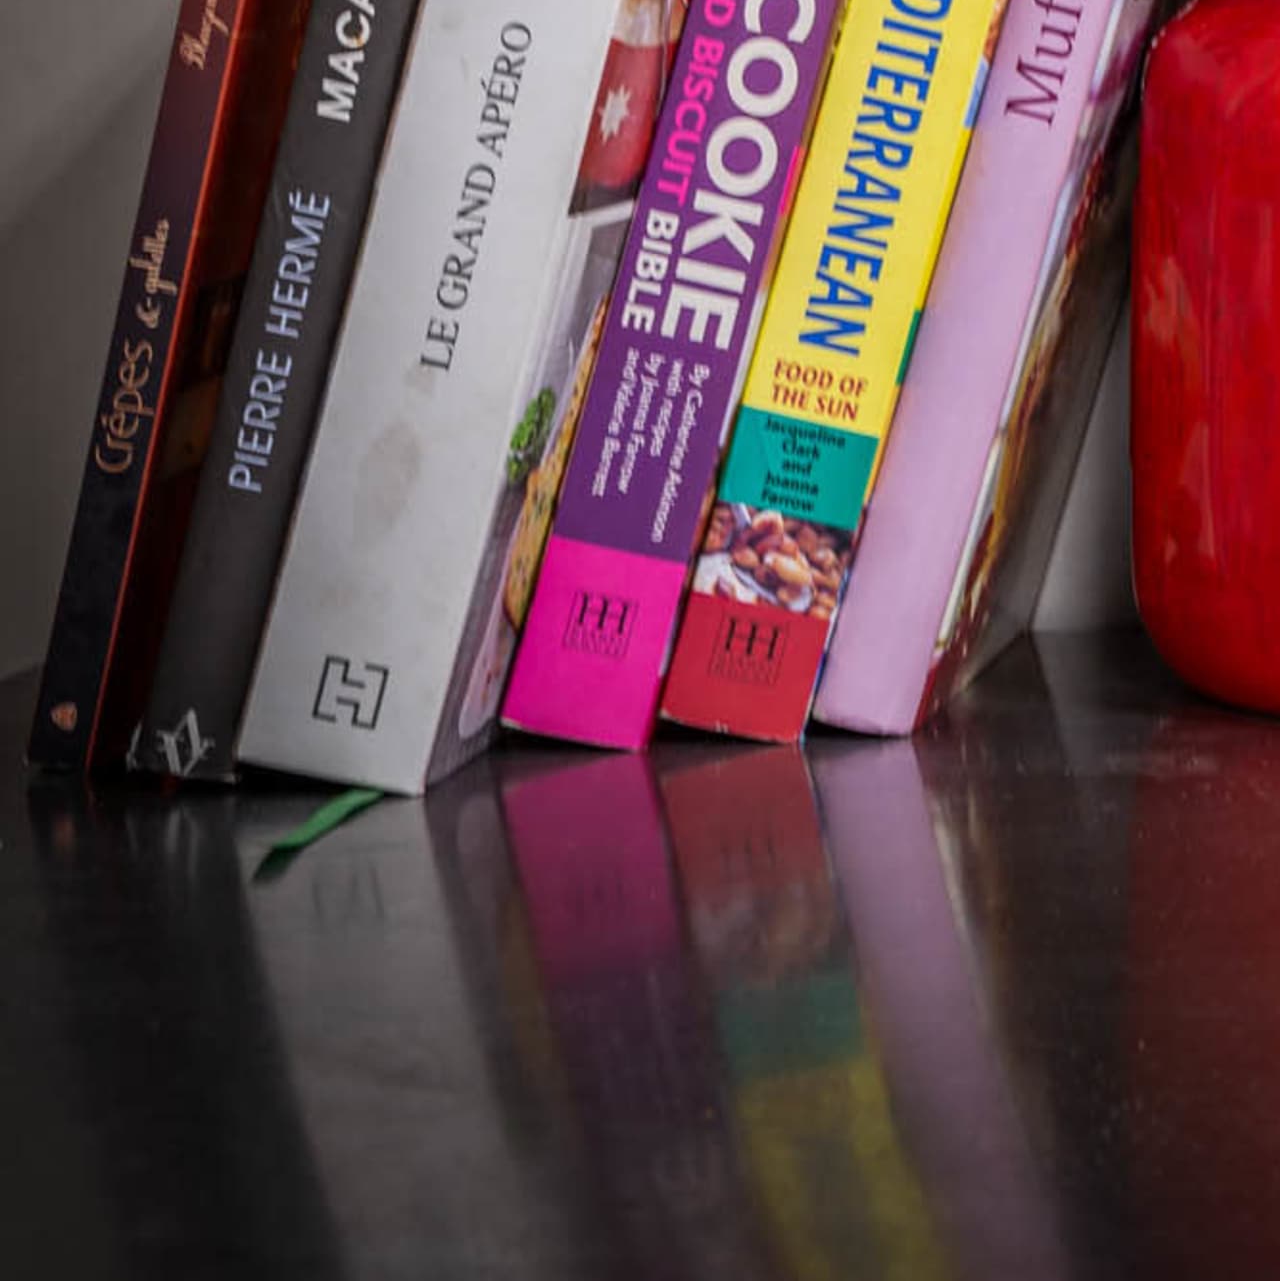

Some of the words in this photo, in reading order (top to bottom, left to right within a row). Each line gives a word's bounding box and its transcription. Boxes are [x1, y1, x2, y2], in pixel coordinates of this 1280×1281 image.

[476, 21, 532, 158] APÉRO
[657, 33, 726, 208] BISCUIT
[436, 162, 497, 311] GRAND
[621, 207, 680, 334] BIBLE
[227, 348, 293, 494] PIERRE
[264, 188, 331, 340] HERMÉ
[420, 316, 460, 372] LE
[772, 383, 809, 412] THE
[814, 394, 859, 421] SUN
[773, 358, 833, 390] FOOD
[838, 374, 868, 398] OF
[781, 459, 813, 478] and
